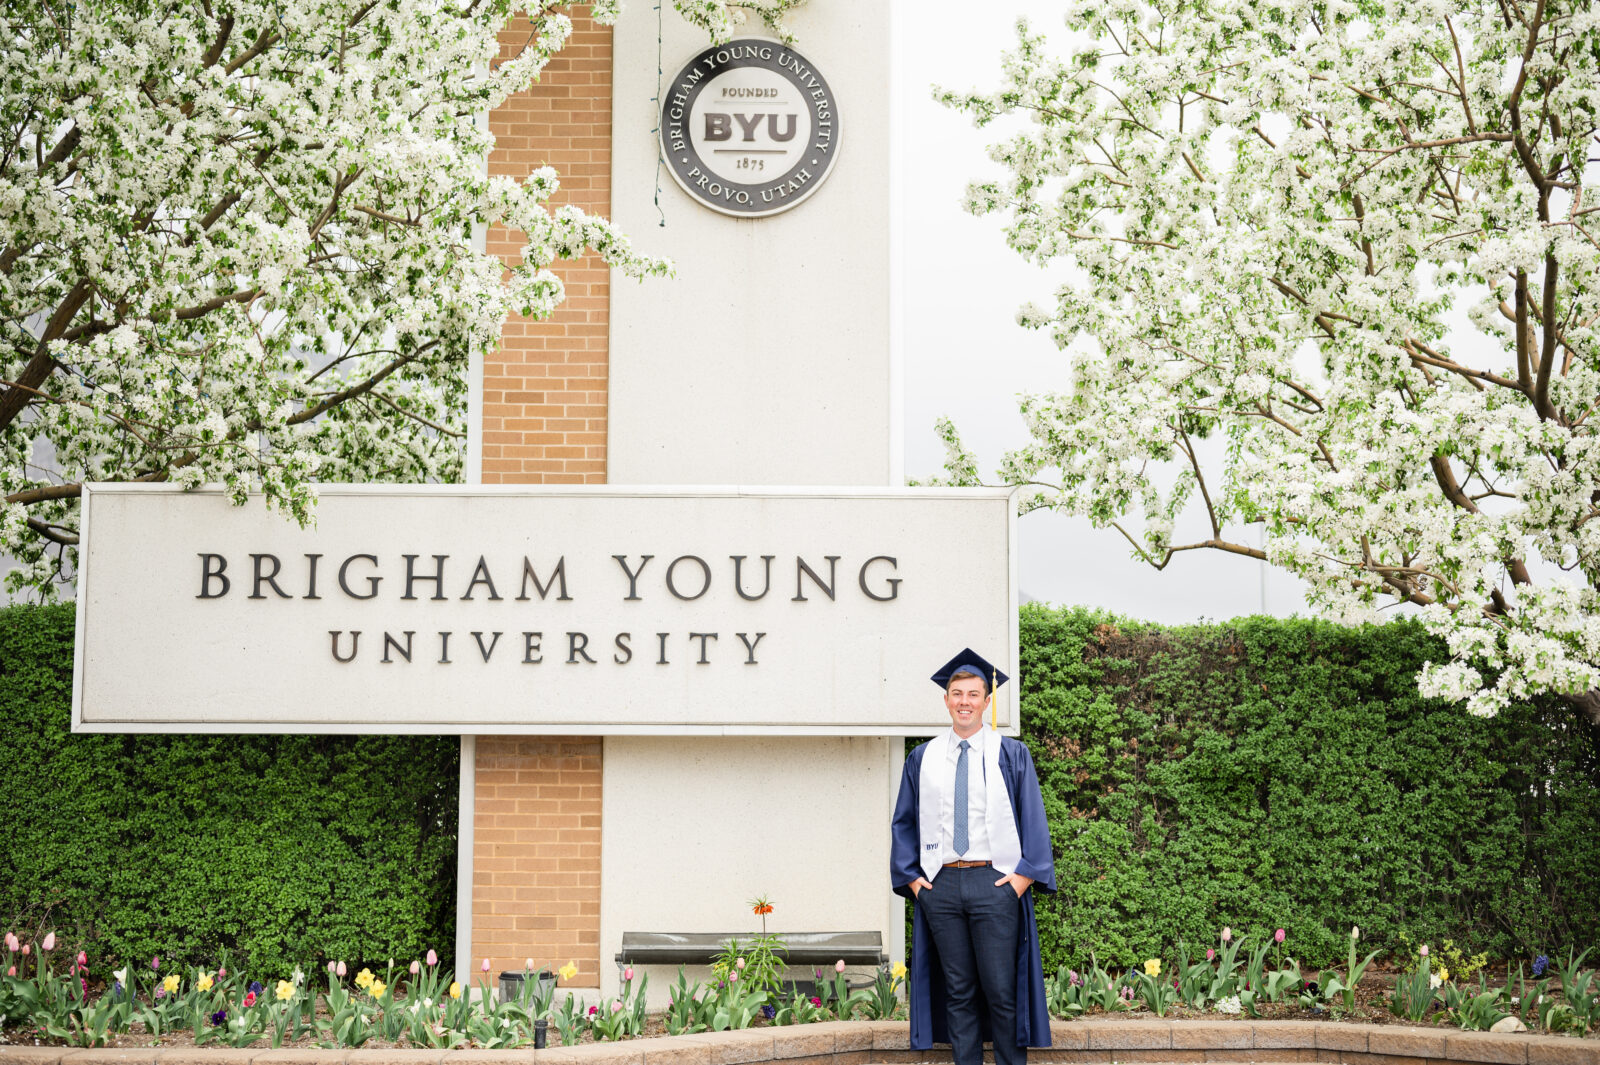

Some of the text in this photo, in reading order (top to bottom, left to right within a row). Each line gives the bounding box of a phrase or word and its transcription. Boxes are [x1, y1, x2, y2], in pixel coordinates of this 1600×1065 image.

[669, 46, 832, 154] BRIGHAM YOUNG UNIVERSITY
[722, 87, 779, 98] FOUNDED
[703, 112, 798, 142] BYU
[735, 157, 765, 171] 1875
[687, 167, 813, 206] PROVO, UTAH
[195, 552, 903, 602] BRIGHAM YOUNG
[328, 630, 767, 665] UNIVERSITY
[926, 843, 939, 851] BYU
